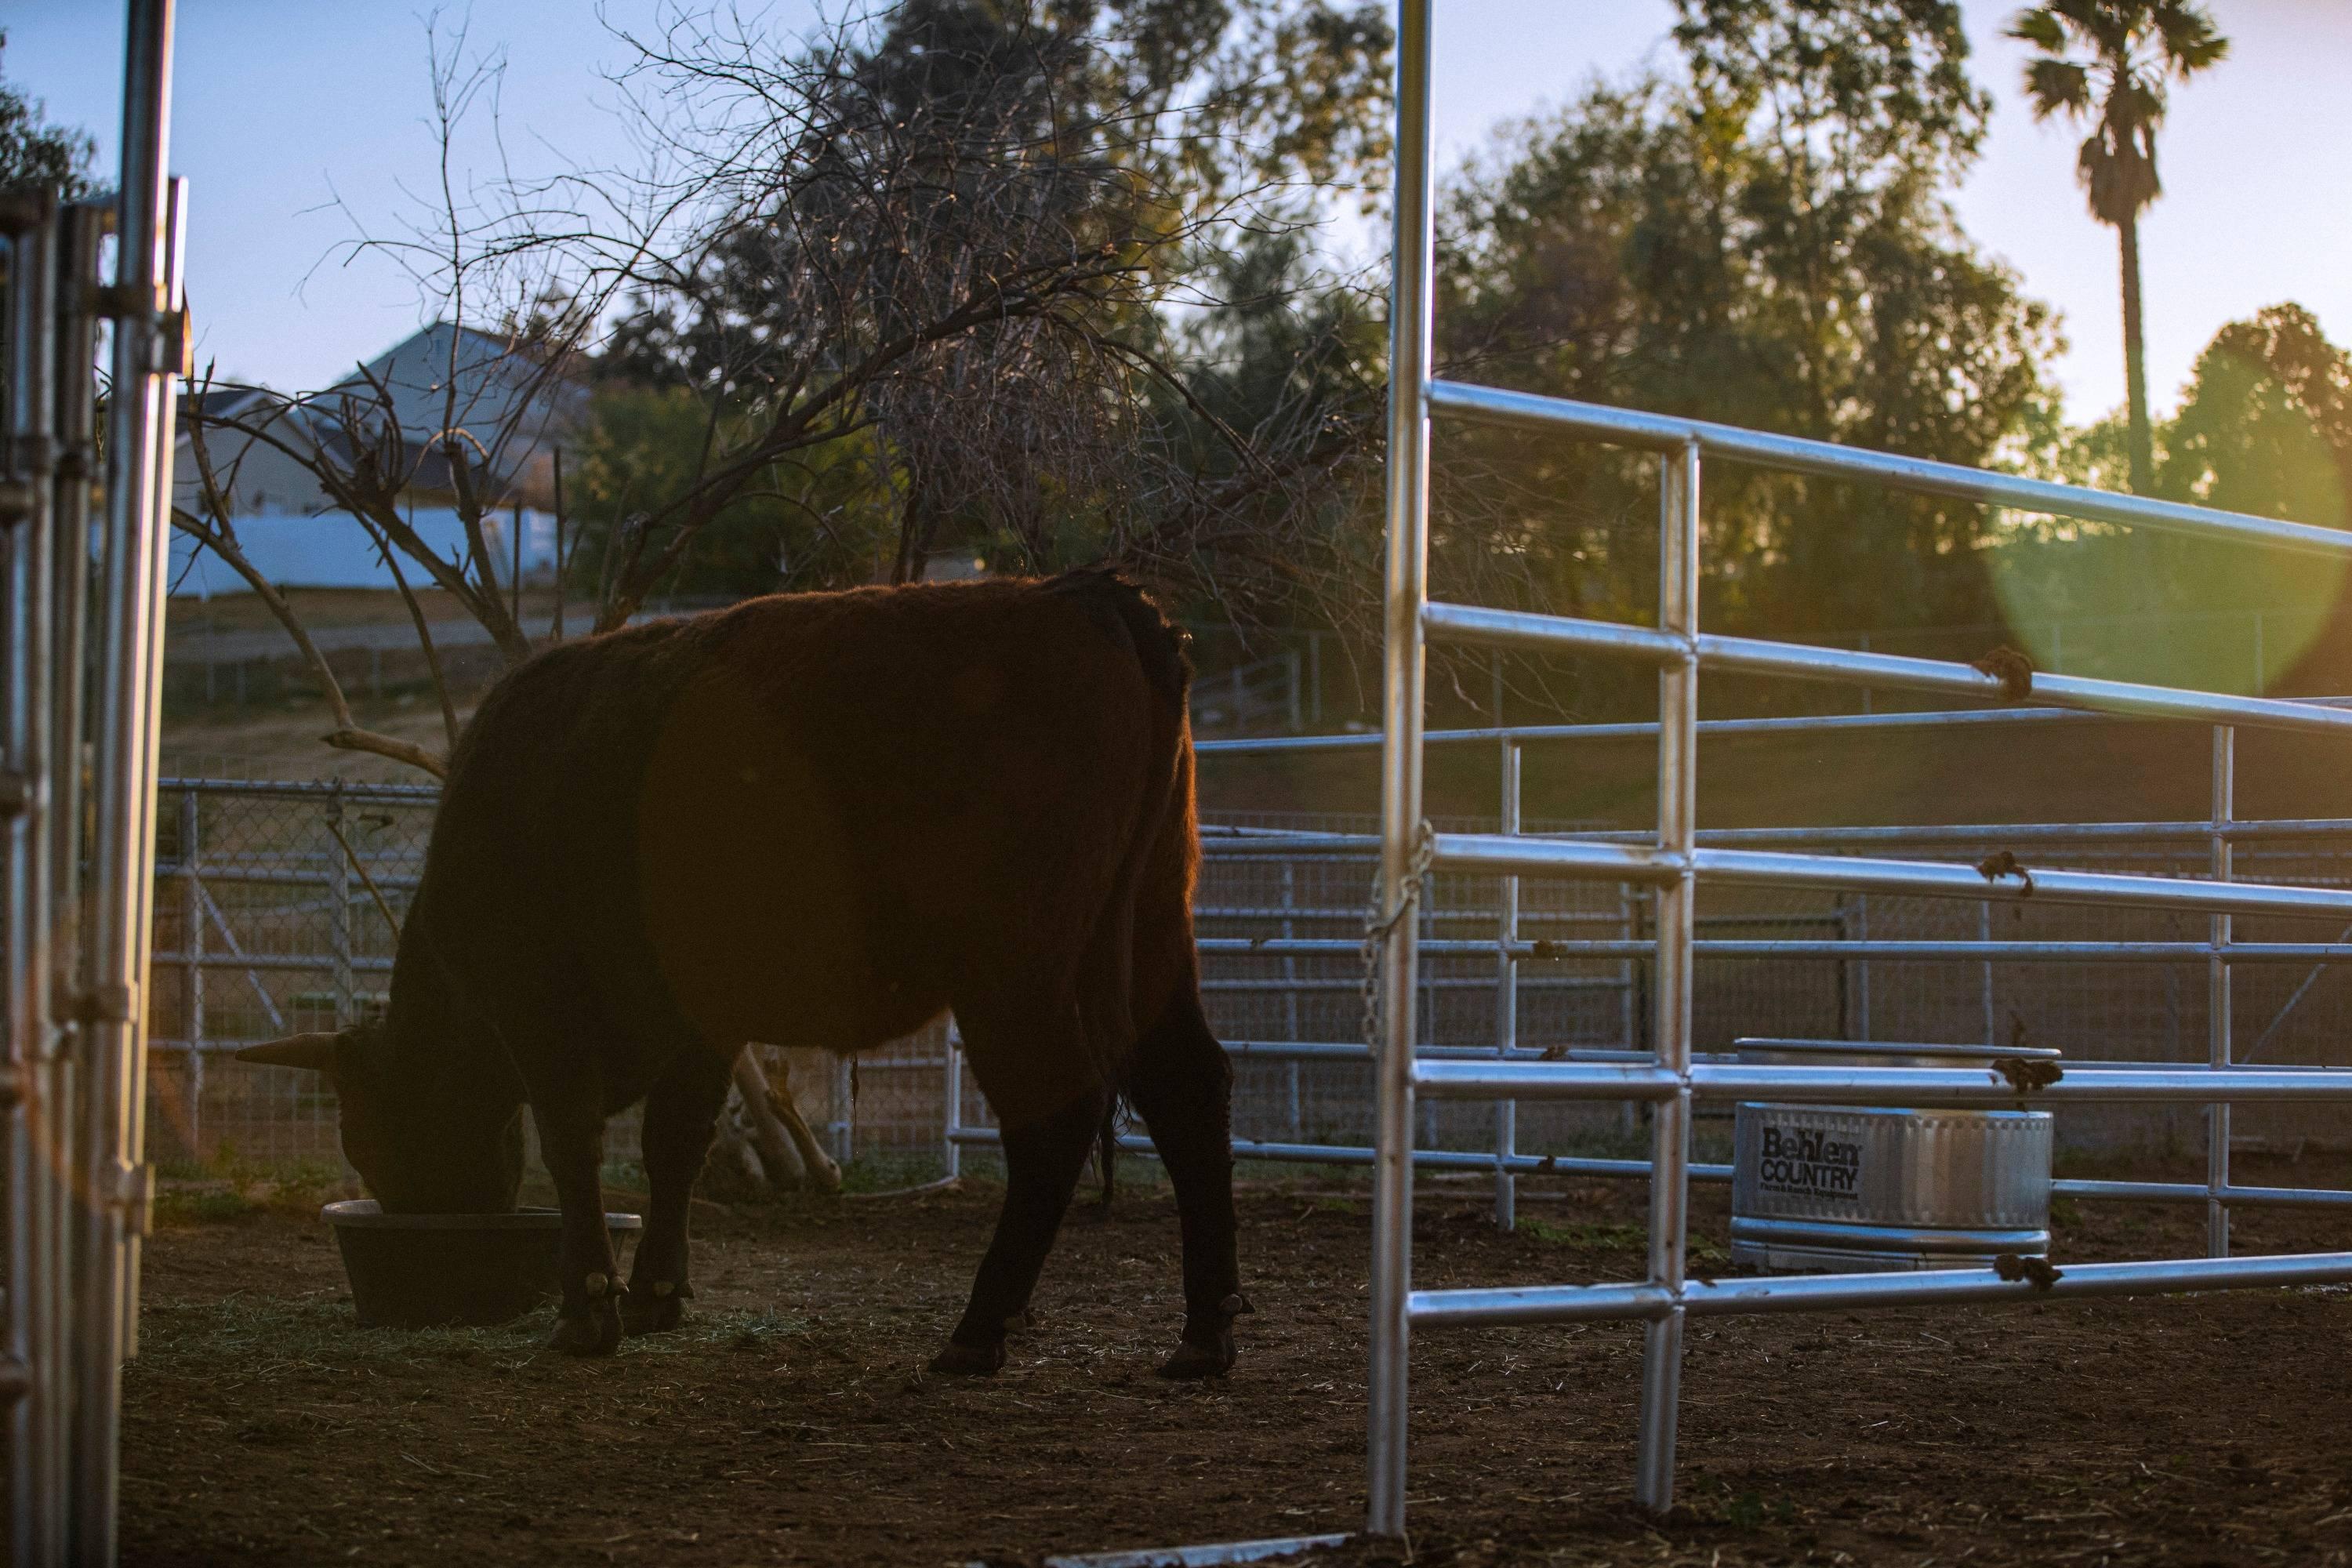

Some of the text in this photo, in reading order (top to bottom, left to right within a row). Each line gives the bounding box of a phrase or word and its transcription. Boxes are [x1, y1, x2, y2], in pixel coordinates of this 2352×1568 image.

[1762, 1127, 1859, 1166] Behlen
[1761, 1159, 1858, 1190] COUNTRY
[1813, 1188, 1858, 1200] Equipment
